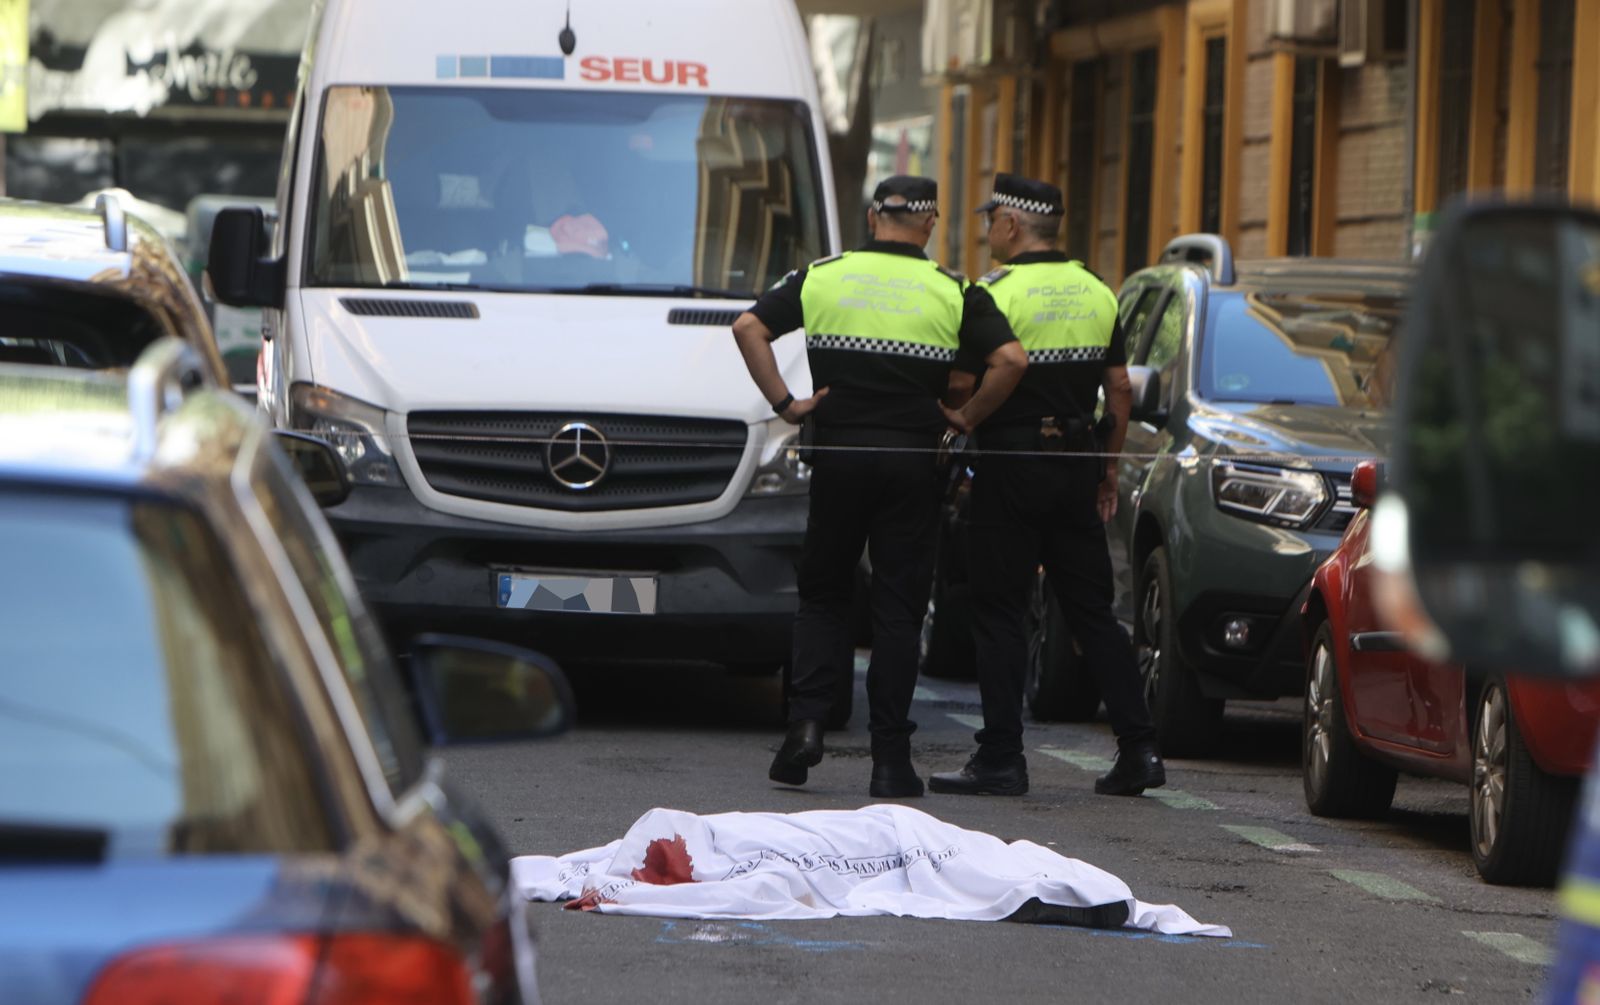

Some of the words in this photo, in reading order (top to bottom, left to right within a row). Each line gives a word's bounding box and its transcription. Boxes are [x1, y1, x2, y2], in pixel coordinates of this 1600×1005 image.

[579, 55, 709, 88] SEUR
[853, 287, 908, 302] LOCAL
[838, 296, 924, 316] SEVILLA
[1042, 298, 1084, 309] LOCAL
[1034, 308, 1098, 323] SEVILLA
